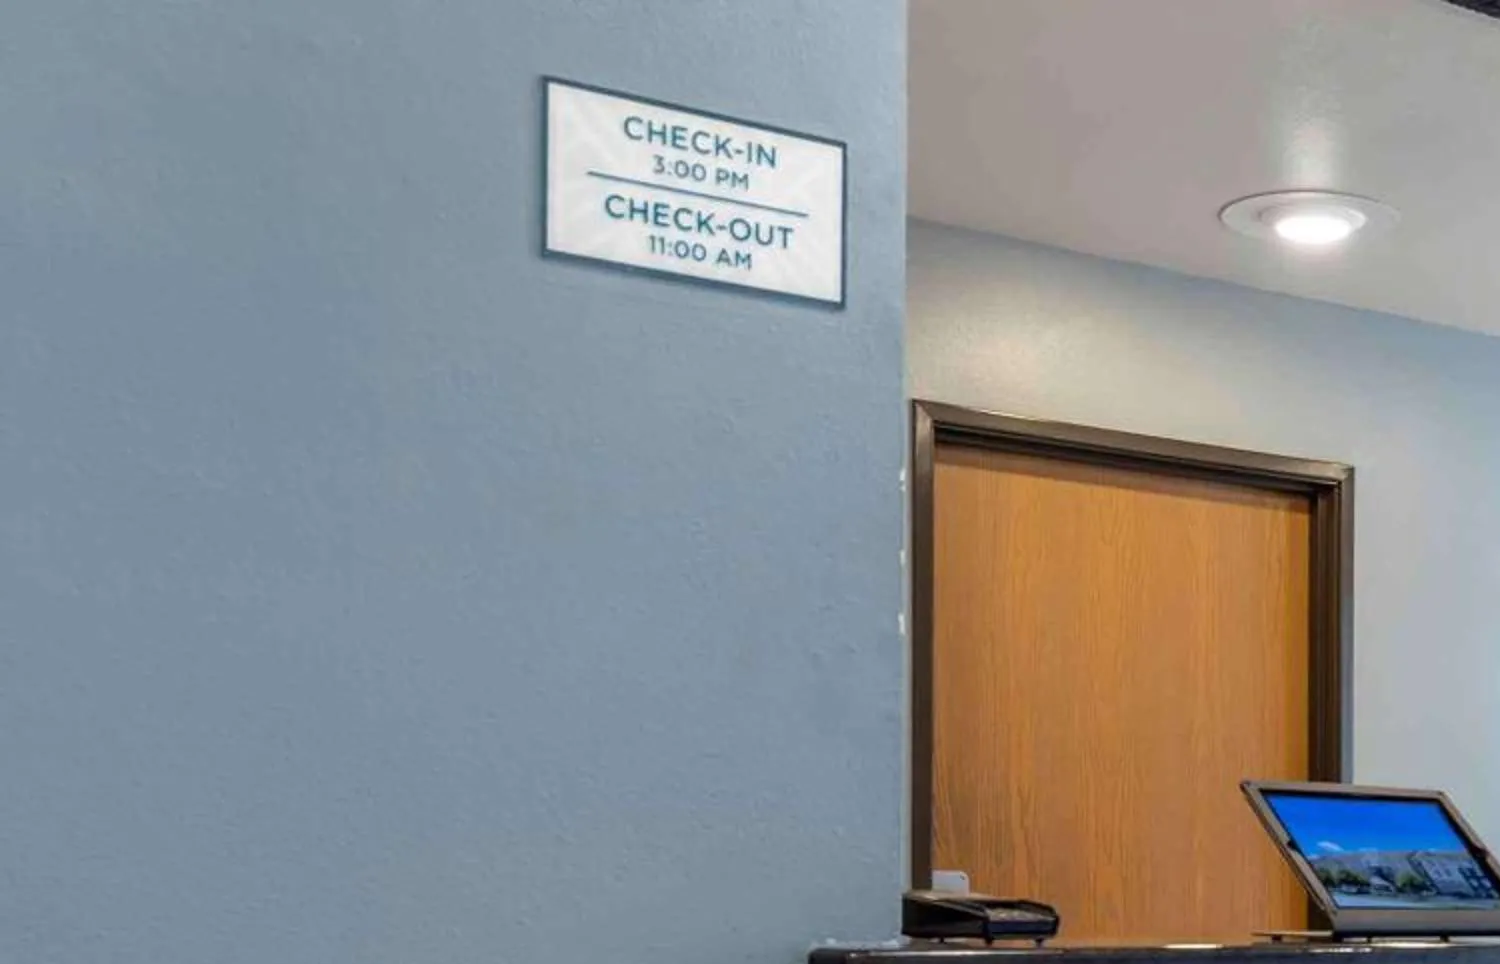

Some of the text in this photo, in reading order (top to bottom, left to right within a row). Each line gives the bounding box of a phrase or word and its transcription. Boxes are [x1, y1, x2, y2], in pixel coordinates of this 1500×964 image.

[623, 115, 777, 168] CHECK-IN
[652, 155, 750, 190] 3:00 PM
[604, 194, 795, 249] CHECK-OUT
[649, 235, 753, 270] 11:00 AM
